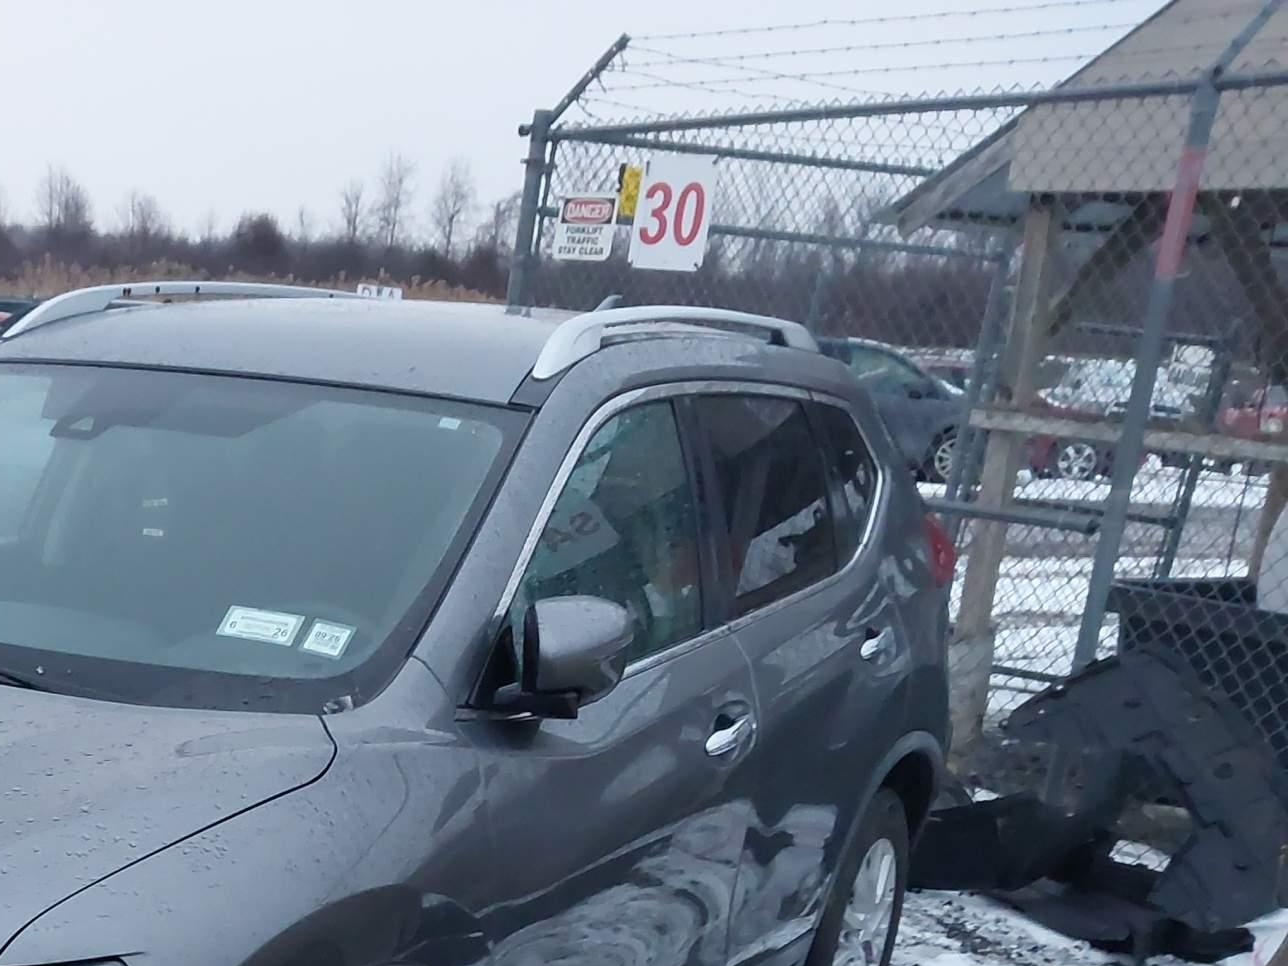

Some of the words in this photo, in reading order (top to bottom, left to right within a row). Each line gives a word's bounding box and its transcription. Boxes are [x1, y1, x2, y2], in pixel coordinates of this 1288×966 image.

[566, 203, 610, 218] DANGER
[639, 181, 705, 246] 30
[566, 226, 604, 235] FORKLIFT
[566, 236, 599, 246] TRAFFIC
[558, 246, 576, 254] STAY
[578, 246, 604, 255] CLEAR
[272, 627, 289, 639] 26
